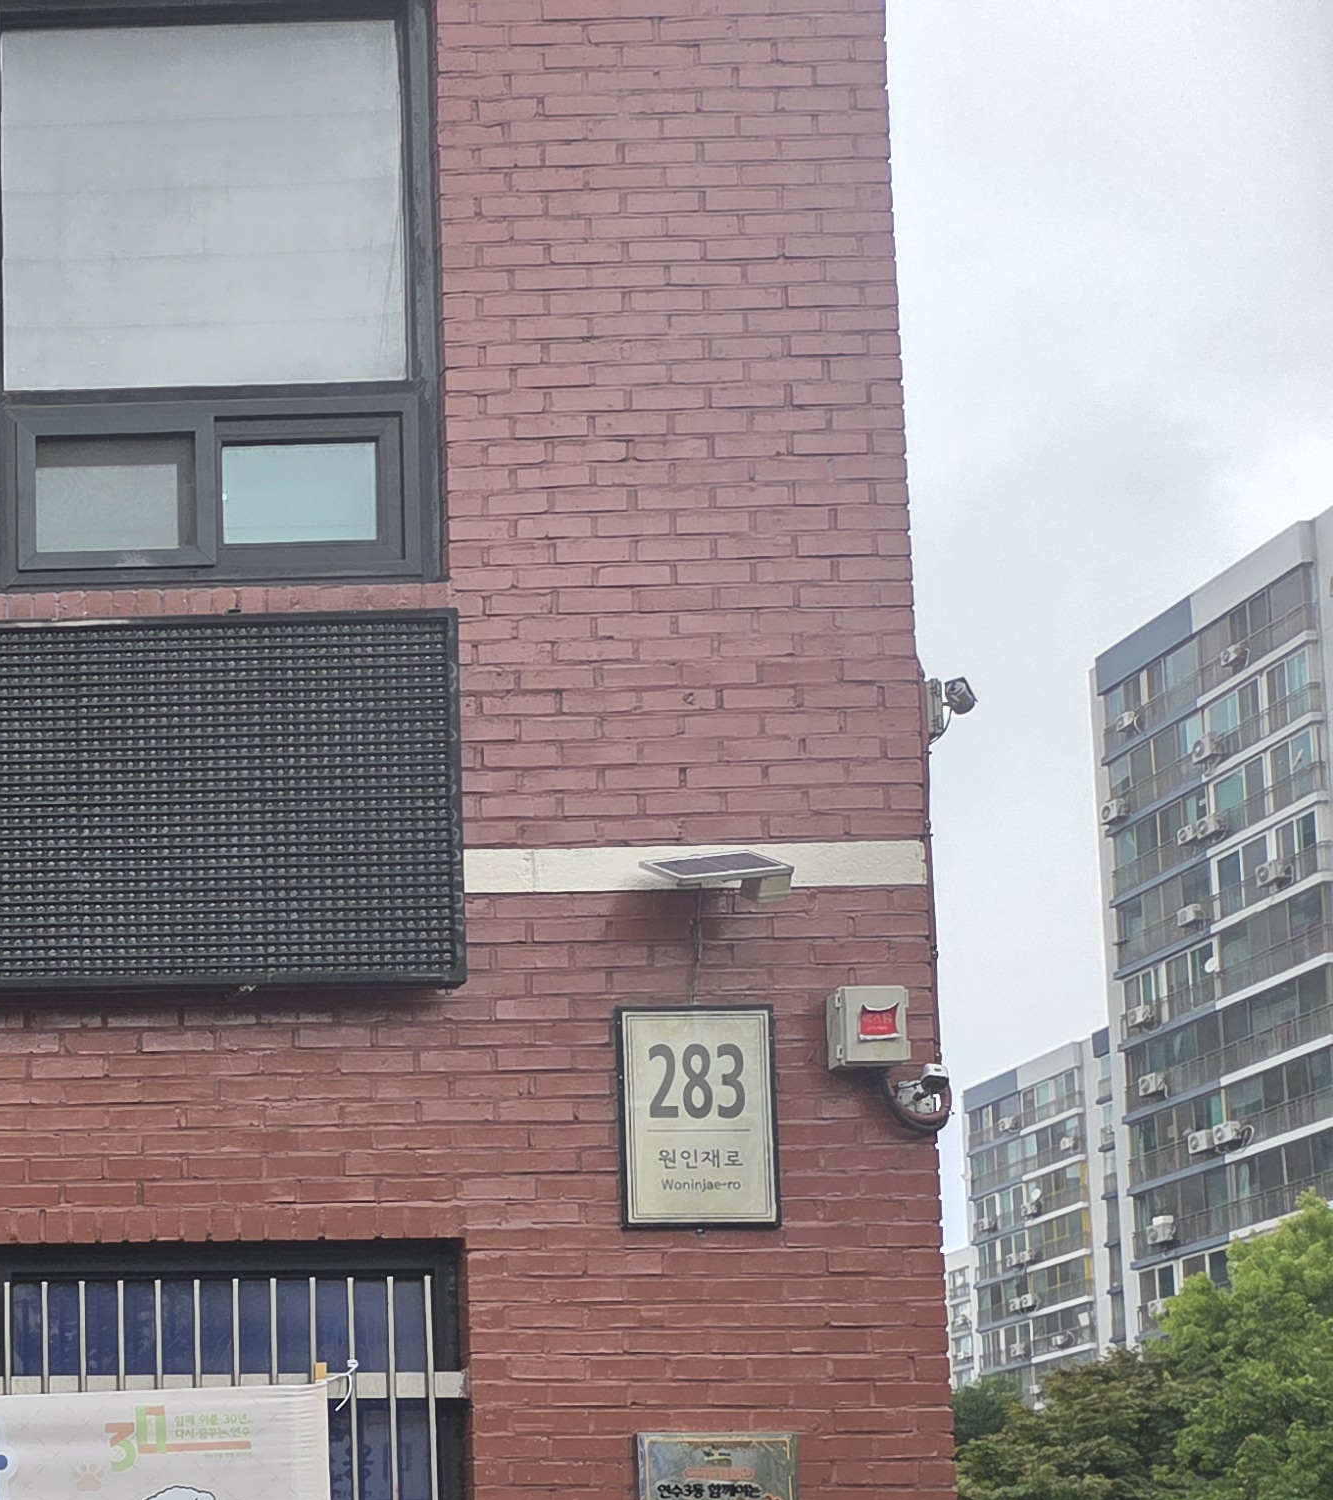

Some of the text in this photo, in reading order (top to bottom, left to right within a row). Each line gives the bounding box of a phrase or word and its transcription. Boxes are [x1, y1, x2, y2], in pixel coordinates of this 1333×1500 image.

[647, 1042, 747, 1119] 283
[658, 1148, 744, 1170] 원인재로
[660, 1178, 742, 1192] Woninjae-ro
[657, 1483, 705, 1499] 연수3동
